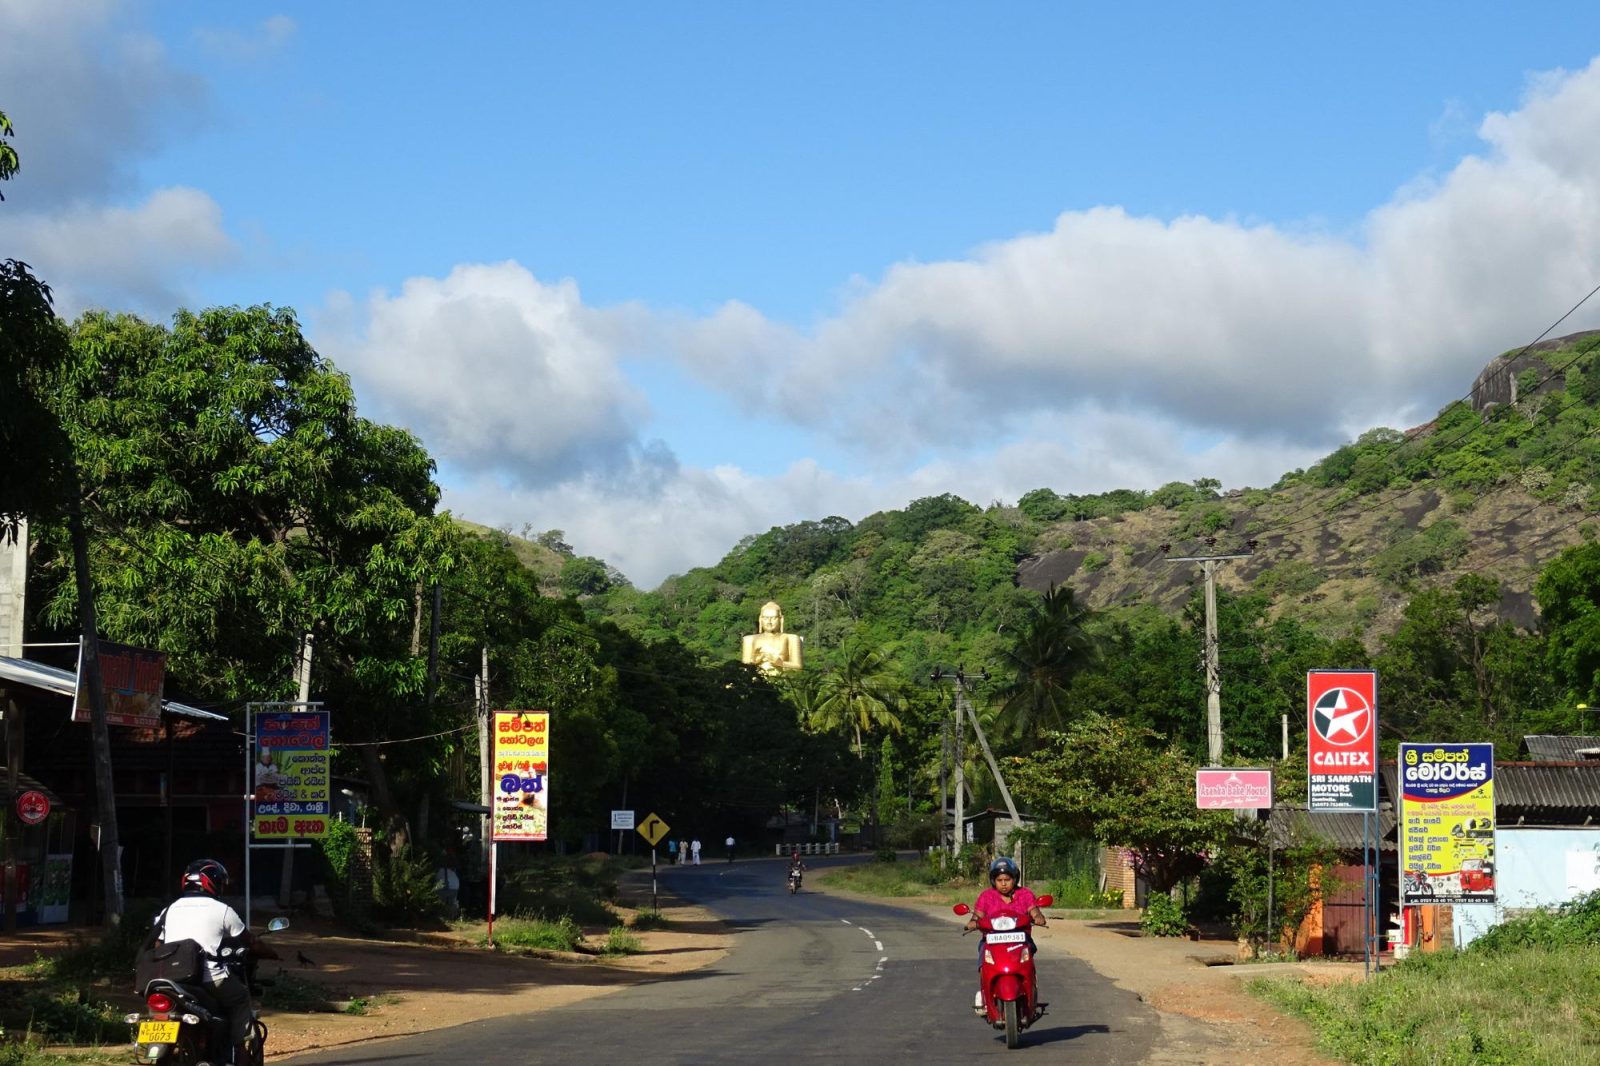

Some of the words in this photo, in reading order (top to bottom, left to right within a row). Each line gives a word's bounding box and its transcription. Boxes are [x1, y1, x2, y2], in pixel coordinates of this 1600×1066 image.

[1313, 751, 1370, 766] CALTEX
[1422, 748, 1469, 763] සම්පත්
[1311, 775, 1326, 783] SRI
[1327, 775, 1372, 783] SAMPATH
[1405, 762, 1487, 781] මෝටර්ස්
[500, 773, 543, 793] බත්
[1311, 784, 1350, 792] MOTORS
